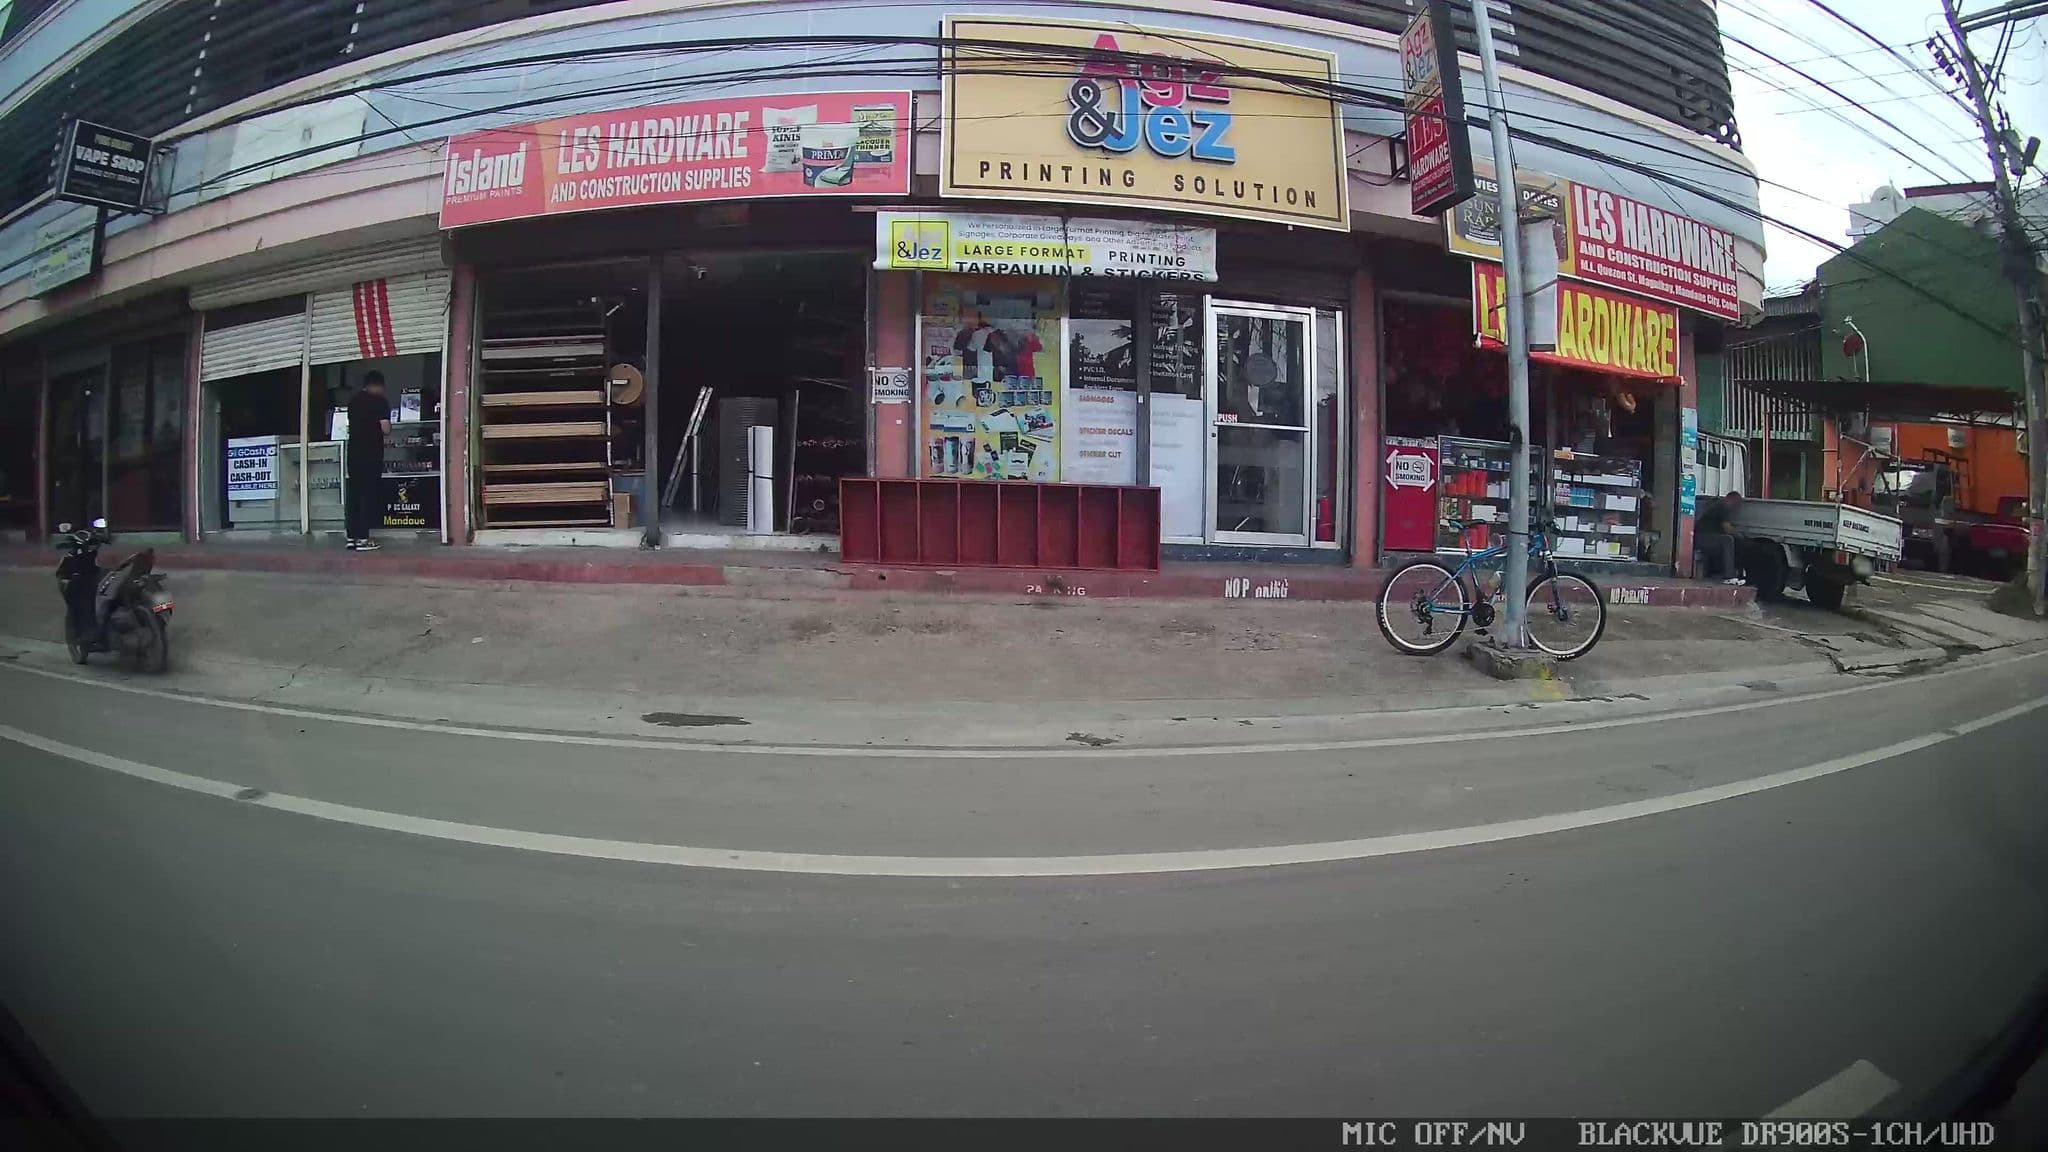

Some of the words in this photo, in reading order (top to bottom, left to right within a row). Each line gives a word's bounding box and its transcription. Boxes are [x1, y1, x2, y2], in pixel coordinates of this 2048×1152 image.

[1079, 33, 1231, 106] Agz
[1411, 103, 1443, 155] LES
[557, 124, 600, 174] LES
[606, 111, 750, 170] HARDWARE
[76, 145, 110, 166] VAPE
[111, 155, 145, 173] SHOP
[446, 141, 528, 196] Island
[1411, 142, 1450, 181] HARDWARE
[551, 181, 577, 203] AND
[579, 171, 682, 200] CONSTRUCTION
[685, 166, 752, 189] SUPPLIES
[980, 161, 1136, 188] PRINTING
[1173, 174, 1318, 208] SOLUTION
[1474, 178, 1499, 192] VIES
[446, 191, 488, 206] PREMIUM
[489, 186, 523, 199] PAINTS
[998, 231, 1039, 240] Corporate
[1574, 184, 1617, 244] LES
[1619, 198, 1736, 281] HARDWARE
[964, 245, 1014, 256] LARGE
[1020, 246, 1085, 259] FORMAT
[1109, 251, 1186, 267] PRINTING
[955, 261, 1072, 278] TARPAULIN
[1081, 266, 1095, 276] &
[1579, 241, 1605, 259] AND
[1607, 247, 1692, 283] CONSTRUCTION
[1693, 275, 1737, 298] SUPPLIES
[1580, 260, 1597, 272] M.L.
[1597, 263, 1627, 280] Quezon
[1479, 273, 1506, 343] LE
[1556, 290, 1674, 377] ARDWARE
[875, 376, 889, 386] NO
[1217, 414, 1238, 423] PUSH
[1108, 428, 1133, 436] DECALS
[233, 458, 268, 469] CASH-IN
[1396, 461, 1409, 471] NO
[230, 471, 271, 482] CASH-OUT
[1395, 473, 1425, 481] SMOKING
[384, 515, 425, 526] Mandaue
[1225, 578, 1241, 598] NO
[1610, 587, 1620, 604] NO
